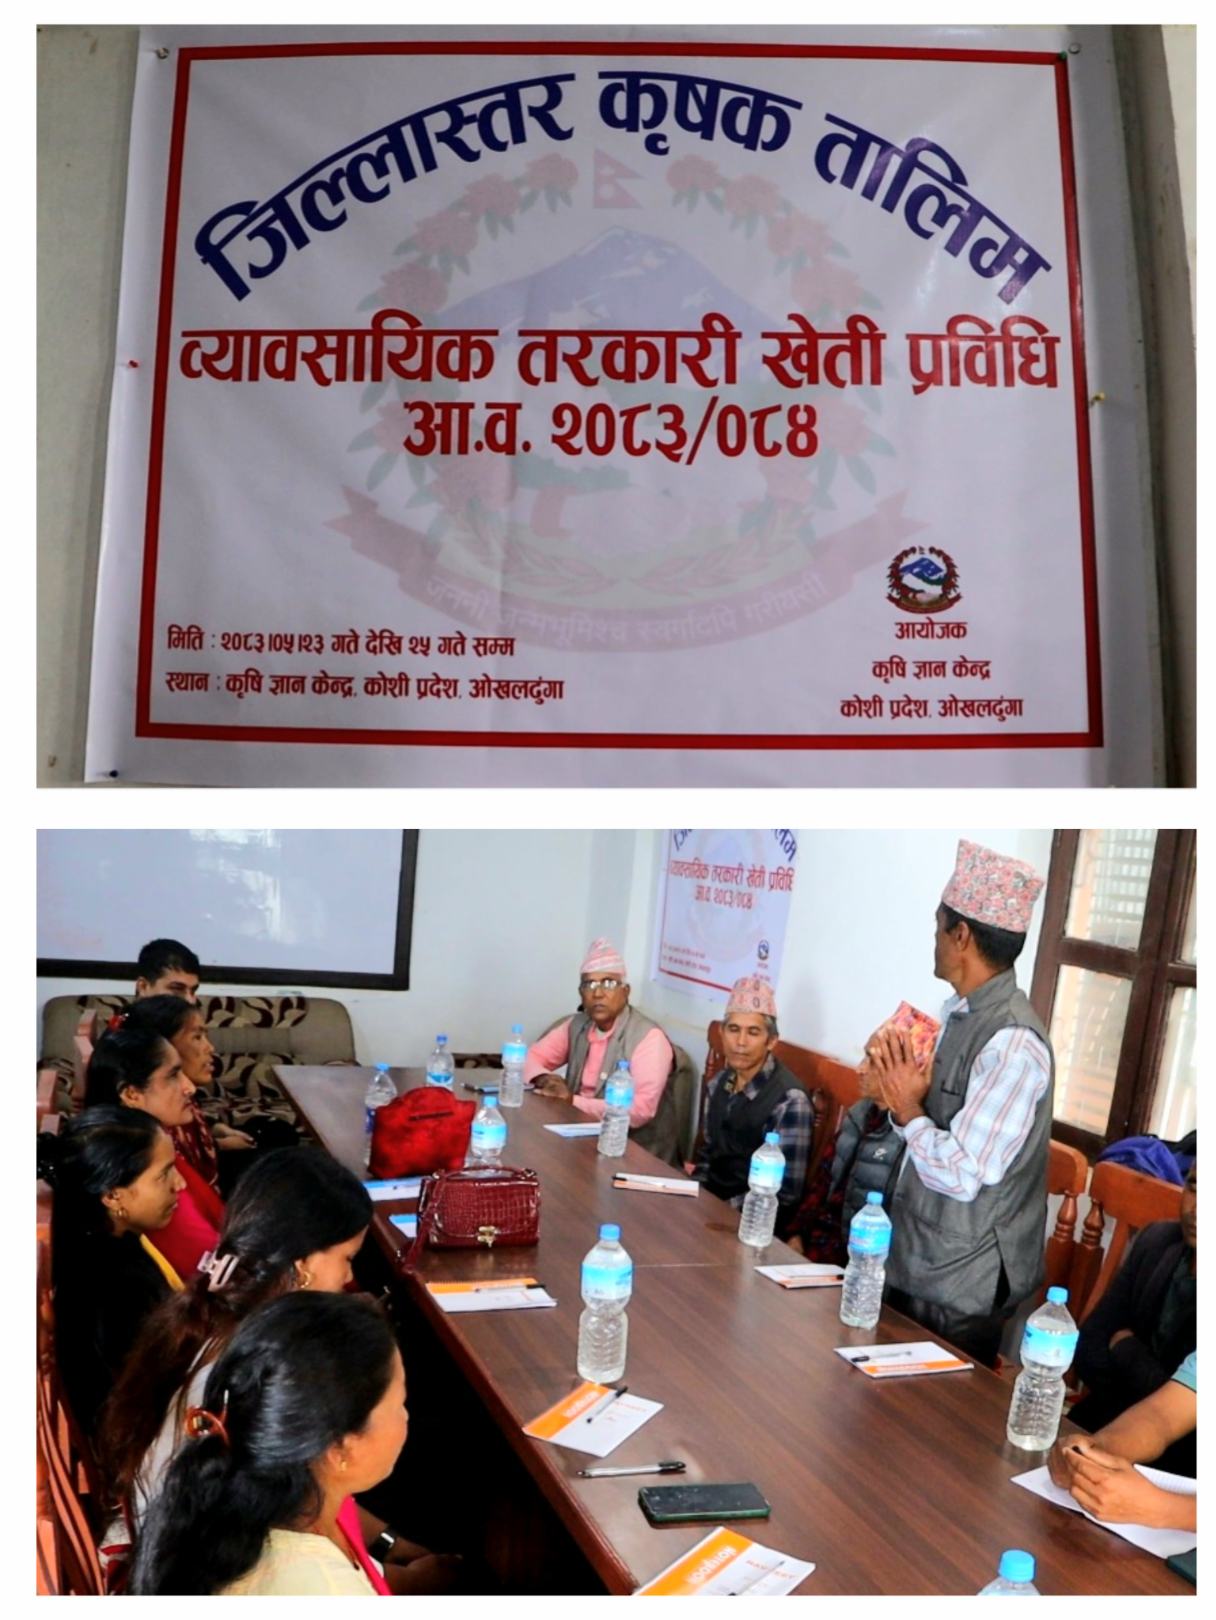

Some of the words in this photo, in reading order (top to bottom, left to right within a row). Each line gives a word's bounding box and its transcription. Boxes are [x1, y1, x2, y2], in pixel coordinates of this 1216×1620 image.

[194, 73, 576, 302] जिल्लास्तर
[598, 70, 803, 155] कृषक
[813, 113, 1052, 304] तालिम
[179, 308, 499, 387] व्यावसायिक
[517, 312, 741, 388] तरकारी
[761, 313, 886, 388] खेती
[906, 314, 1060, 394] प्रविधि
[403, 401, 532, 457] आ.व.
[552, 396, 819, 465] २०८३/०८४
[168, 624, 204, 650] मिति
[332, 629, 359, 656] गते
[366, 629, 401, 656] देखि
[409, 637, 430, 658] २५
[438, 631, 466, 657] गते
[472, 637, 515, 656] सम्म
[895, 616, 968, 639] आयोजक
[166, 672, 209, 692] स्थान
[226, 668, 263, 699] कृषि
[269, 675, 306, 695] ज्ञान
[364, 671, 410, 698] कोशी
[872, 655, 906, 684] कृषि
[913, 660, 947, 680] ज्ञान
[953, 655, 991, 680] केन्द्र
[840, 694, 883, 719] कोशी
